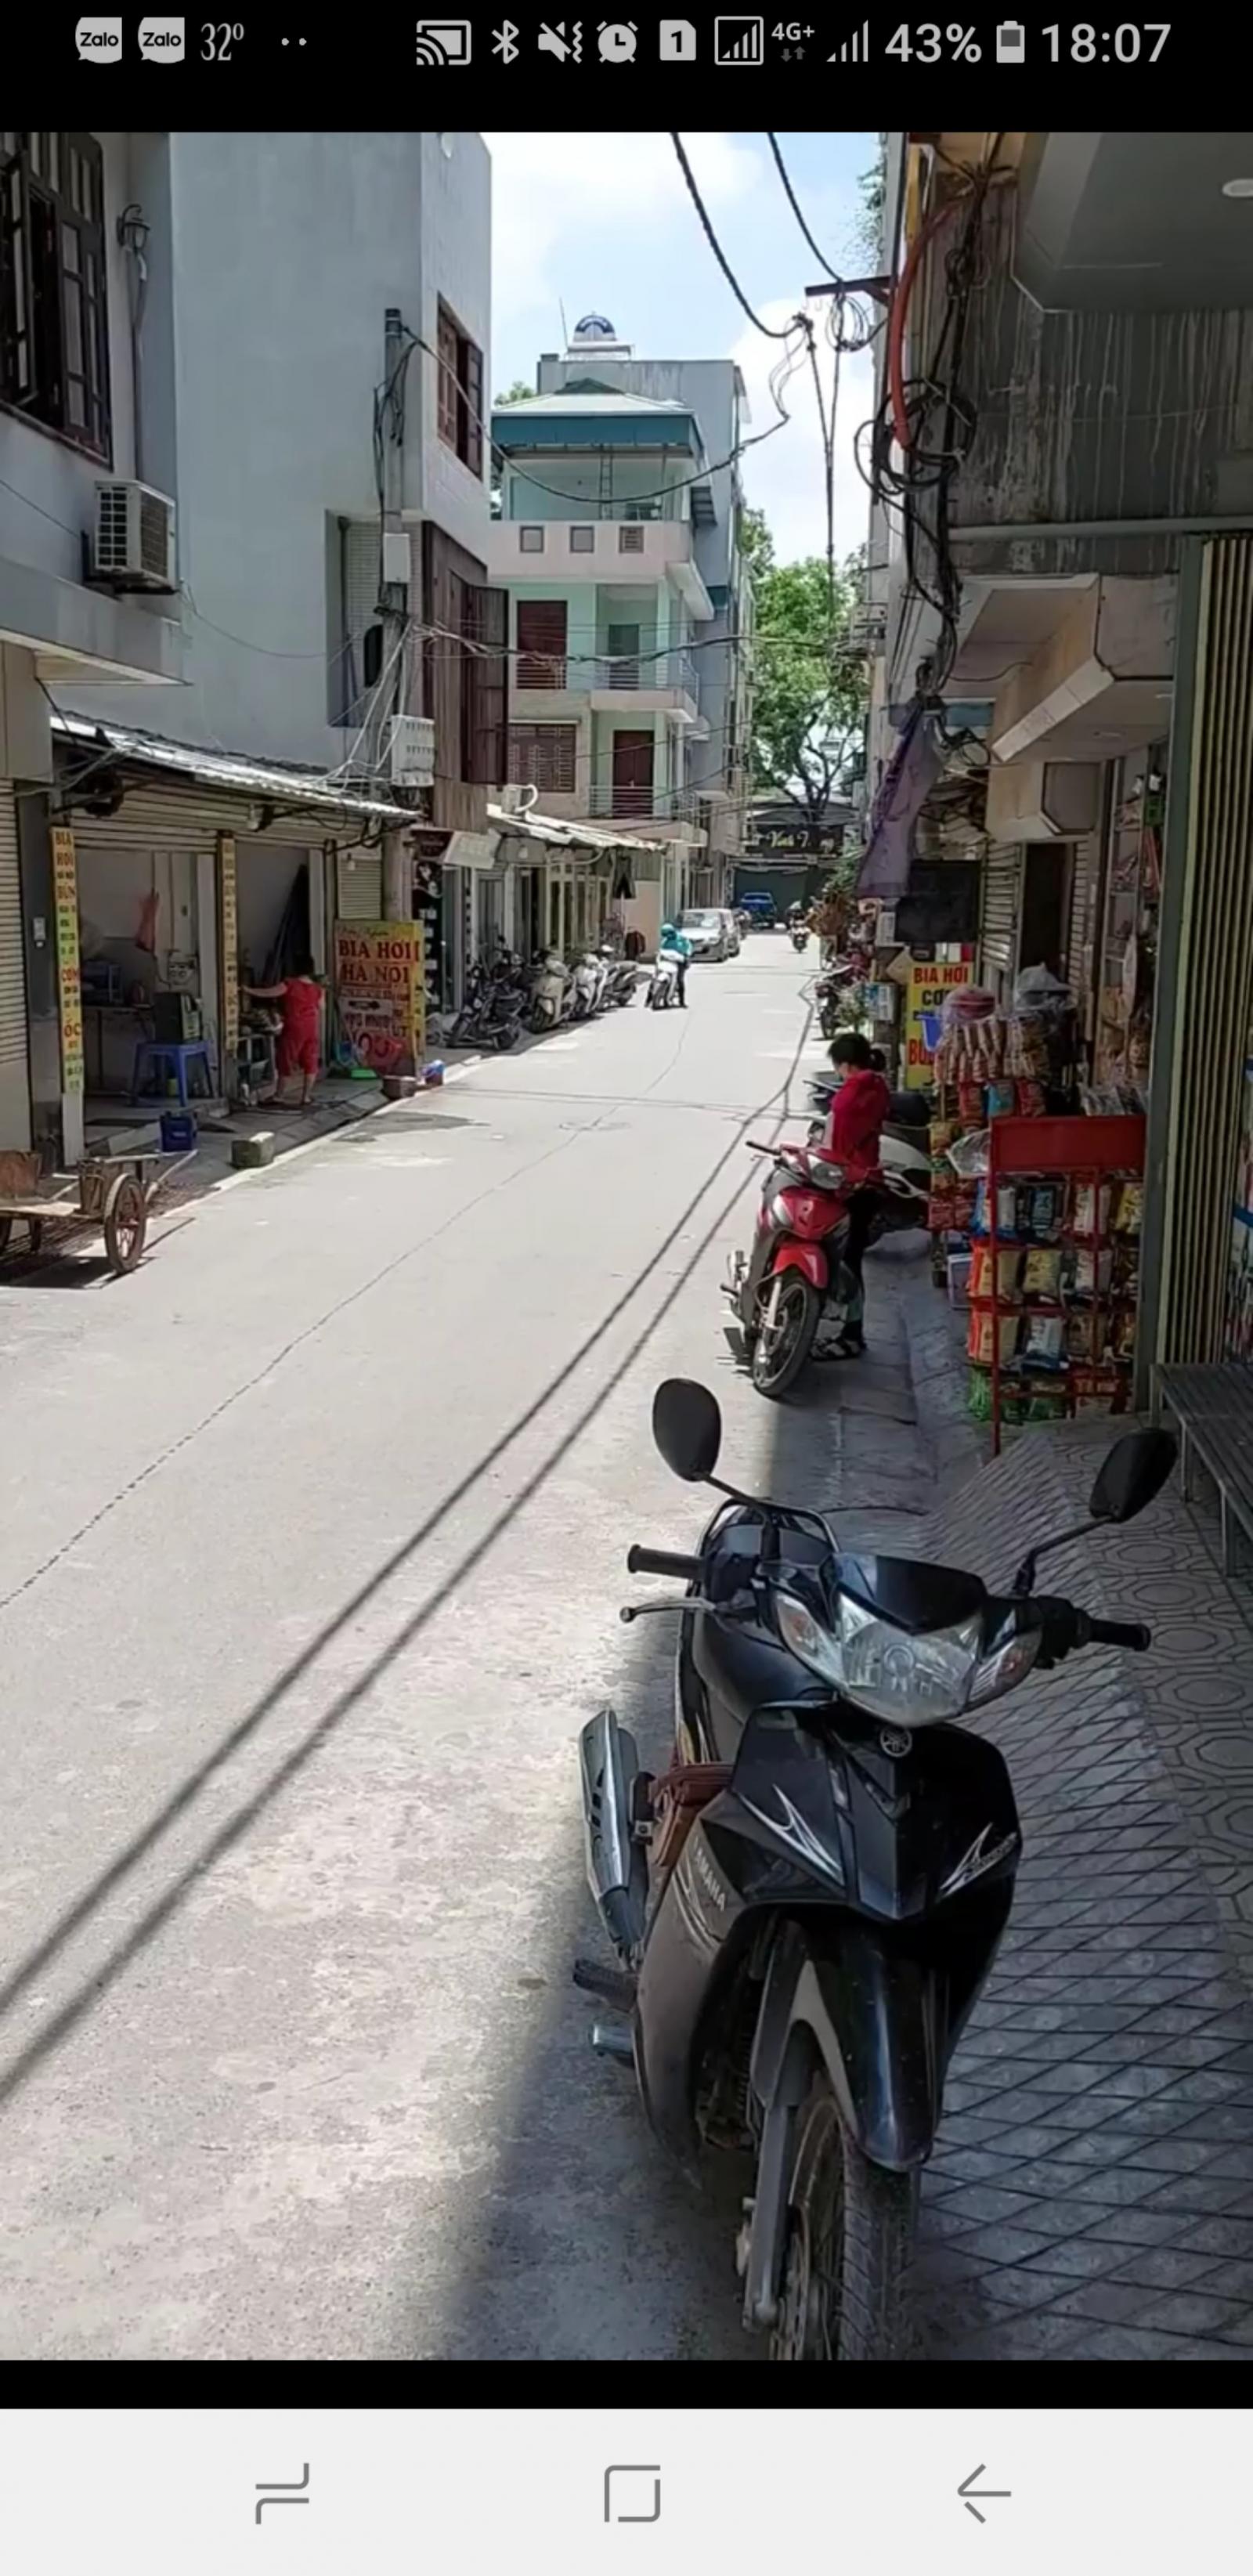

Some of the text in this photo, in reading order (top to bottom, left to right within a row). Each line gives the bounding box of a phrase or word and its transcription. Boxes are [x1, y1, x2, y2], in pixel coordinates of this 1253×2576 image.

[338, 939, 370, 959] BIA
[913, 966, 939, 985] BIA
[922, 988, 949, 1006] CƠ
